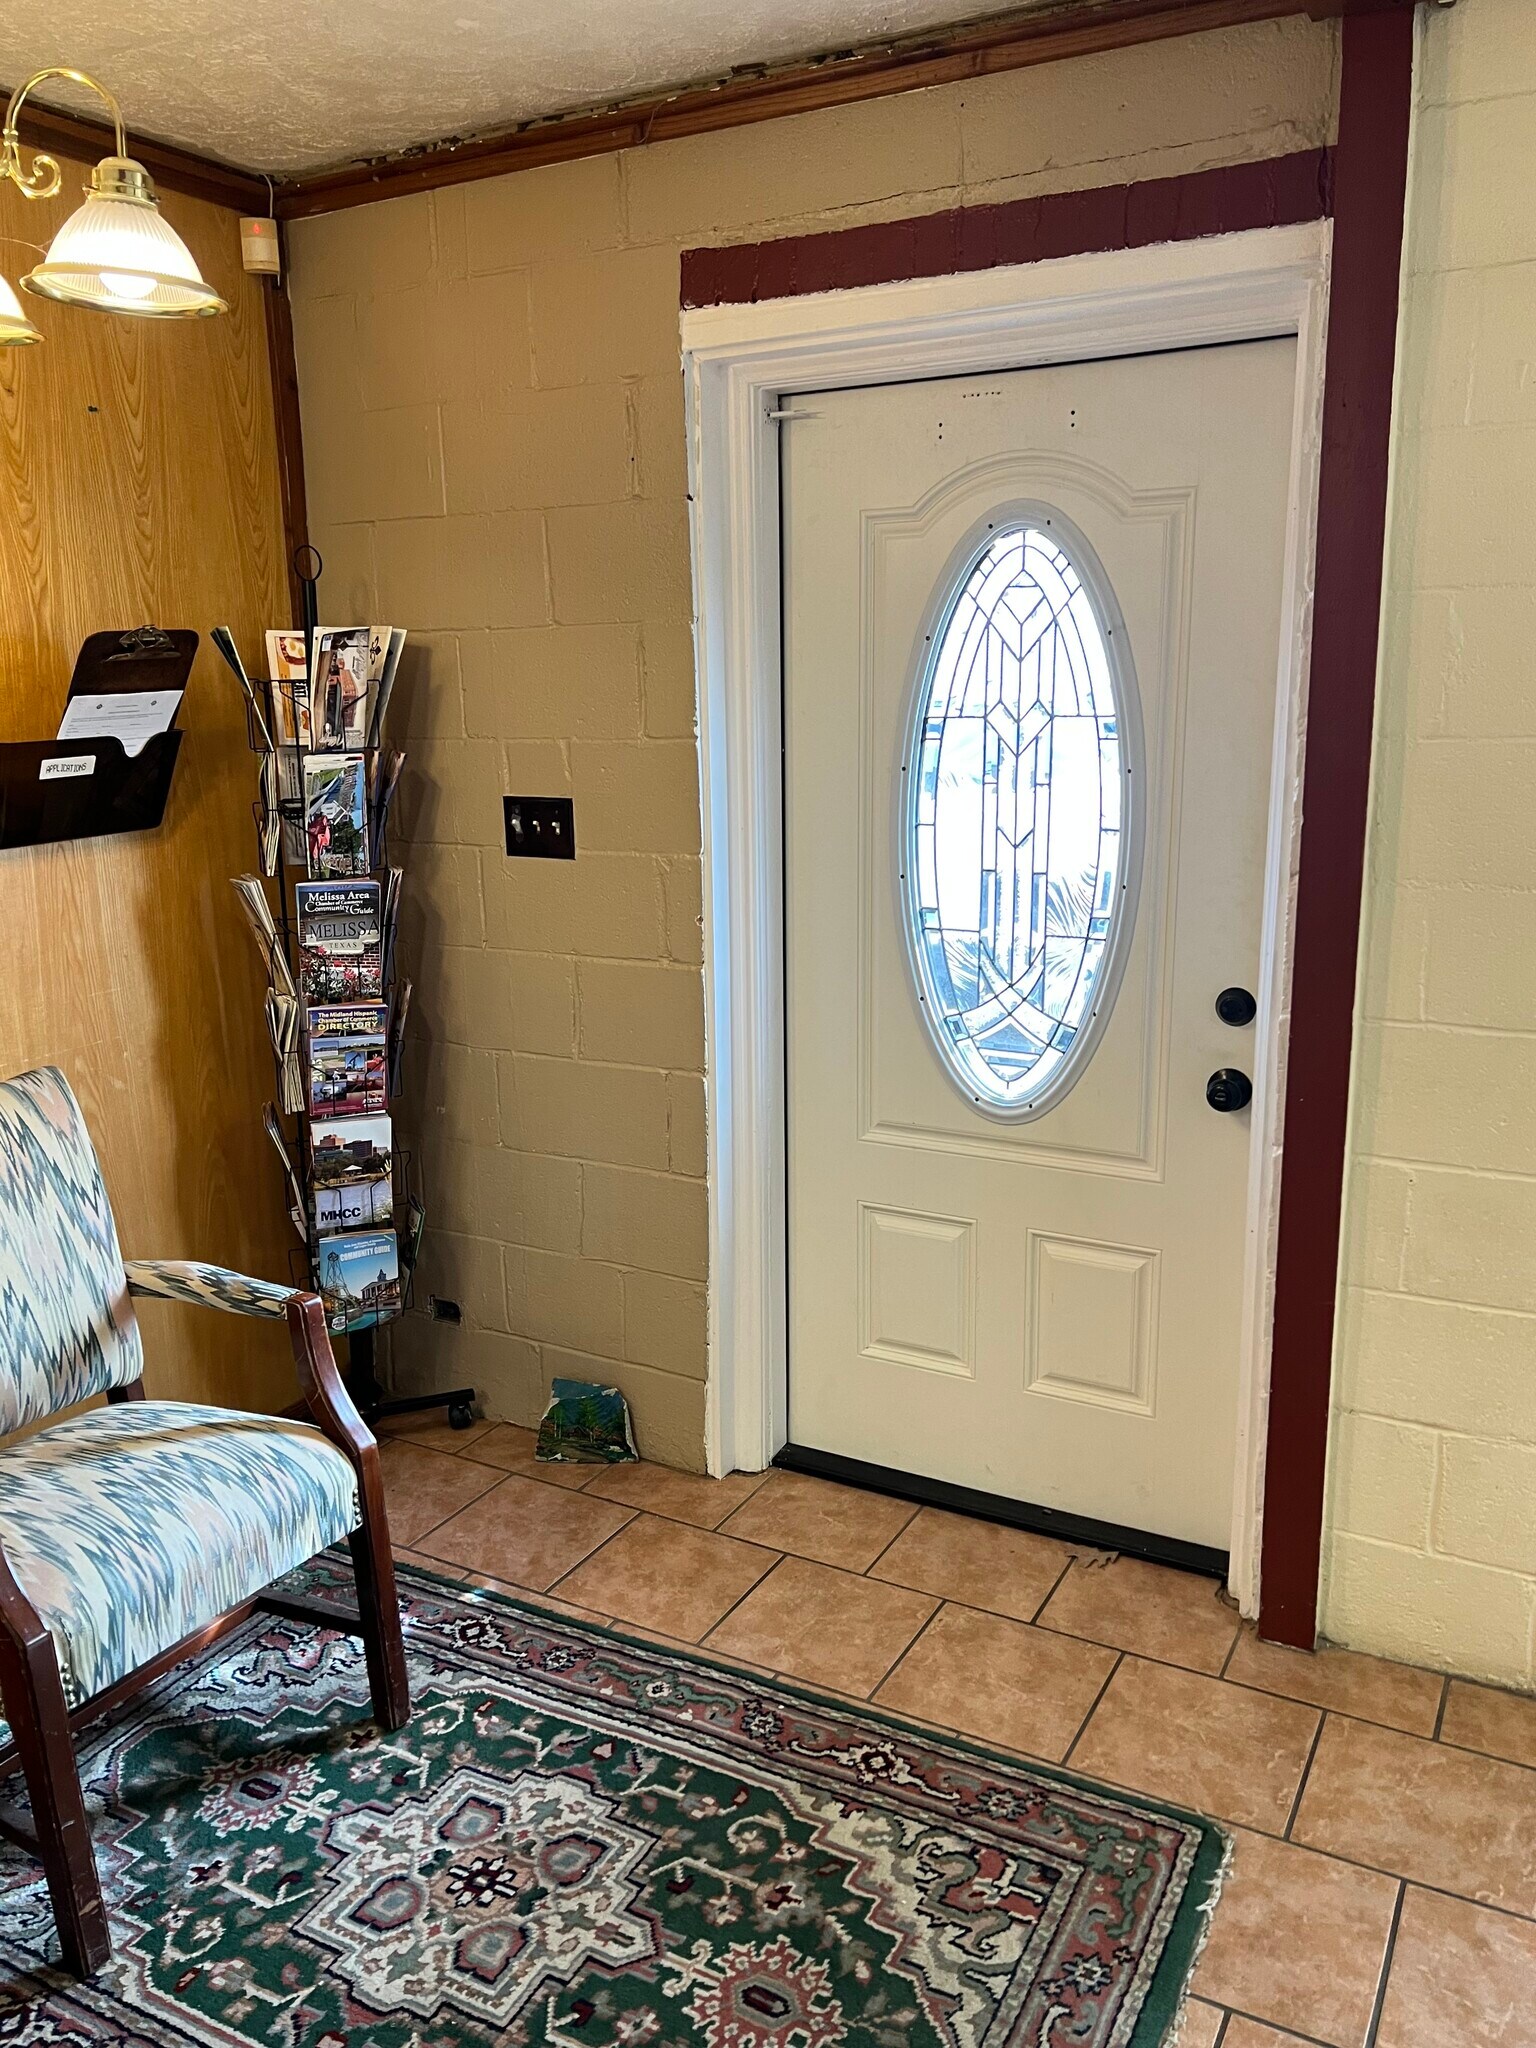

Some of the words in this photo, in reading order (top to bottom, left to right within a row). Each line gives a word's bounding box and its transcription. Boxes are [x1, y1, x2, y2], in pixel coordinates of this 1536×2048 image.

[46, 762, 88, 774] APPLICATIONS
[308, 891, 346, 902] Melissa
[347, 890, 370, 900] Area
[305, 901, 350, 913] Community
[350, 903, 375, 915] Guide
[309, 919, 380, 939] MELISSA
[328, 941, 358, 949] TEXAS
[318, 1020, 378, 1031] DIRECTORY
[320, 1207, 362, 1222] MHCC
[340, 1247, 374, 1262] COMMUNITY
[374, 1244, 391, 1255] GUIDE
